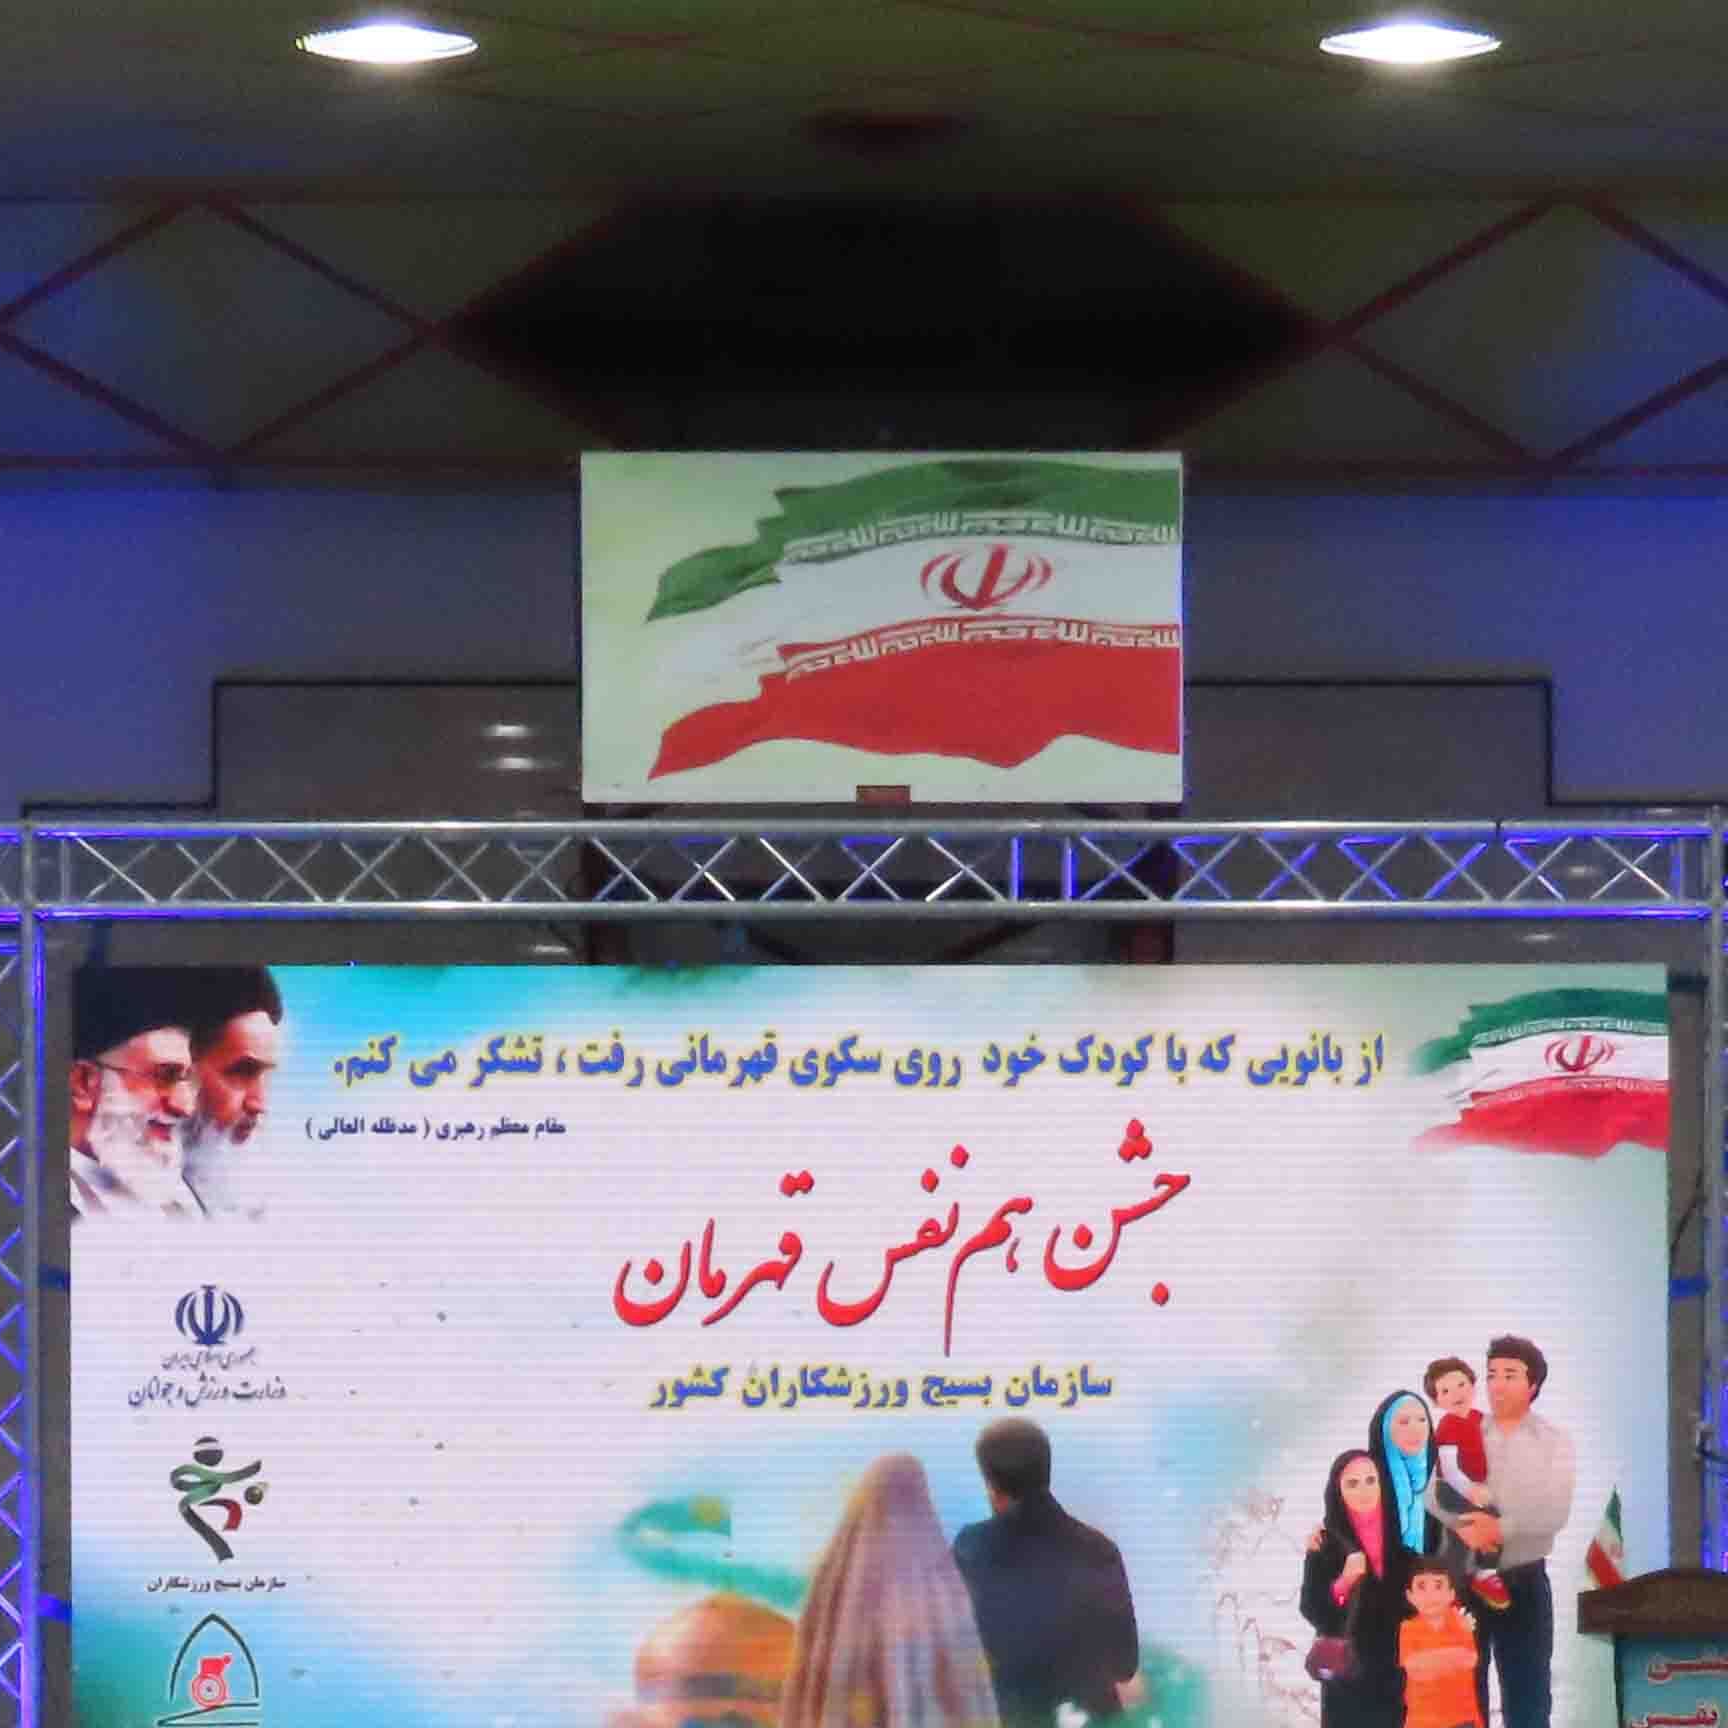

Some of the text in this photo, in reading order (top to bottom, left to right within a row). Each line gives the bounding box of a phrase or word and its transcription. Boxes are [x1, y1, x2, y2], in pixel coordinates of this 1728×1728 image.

[469, 1035, 545, 1088] تشکر
[655, 1032, 780, 1088] قهرمانی
[788, 1035, 882, 1087] سکوی
[893, 1048, 962, 1087] روی
[982, 1034, 1046, 1087] خود
[1058, 1034, 1153, 1087] کودک
[1166, 1034, 1189, 1085] با
[1198, 1034, 1236, 1074] که
[1247, 1034, 1344, 1087] بانویی
[1354, 1034, 1385, 1087] از
[435, 1117, 485, 1142] رهبری
[490, 1115, 530, 1139] معظم
[534, 1116, 567, 1140] مقام
[816, 1143, 970, 1327] نفس
[1043, 1118, 1190, 1306] جشن
[613, 1170, 816, 1327] قهرمان
[649, 1363, 1113, 1408] سازمان بسیج ورزشکاران کشور
[146, 1575, 287, 1594] سازمان بسیج ورزشکاران
